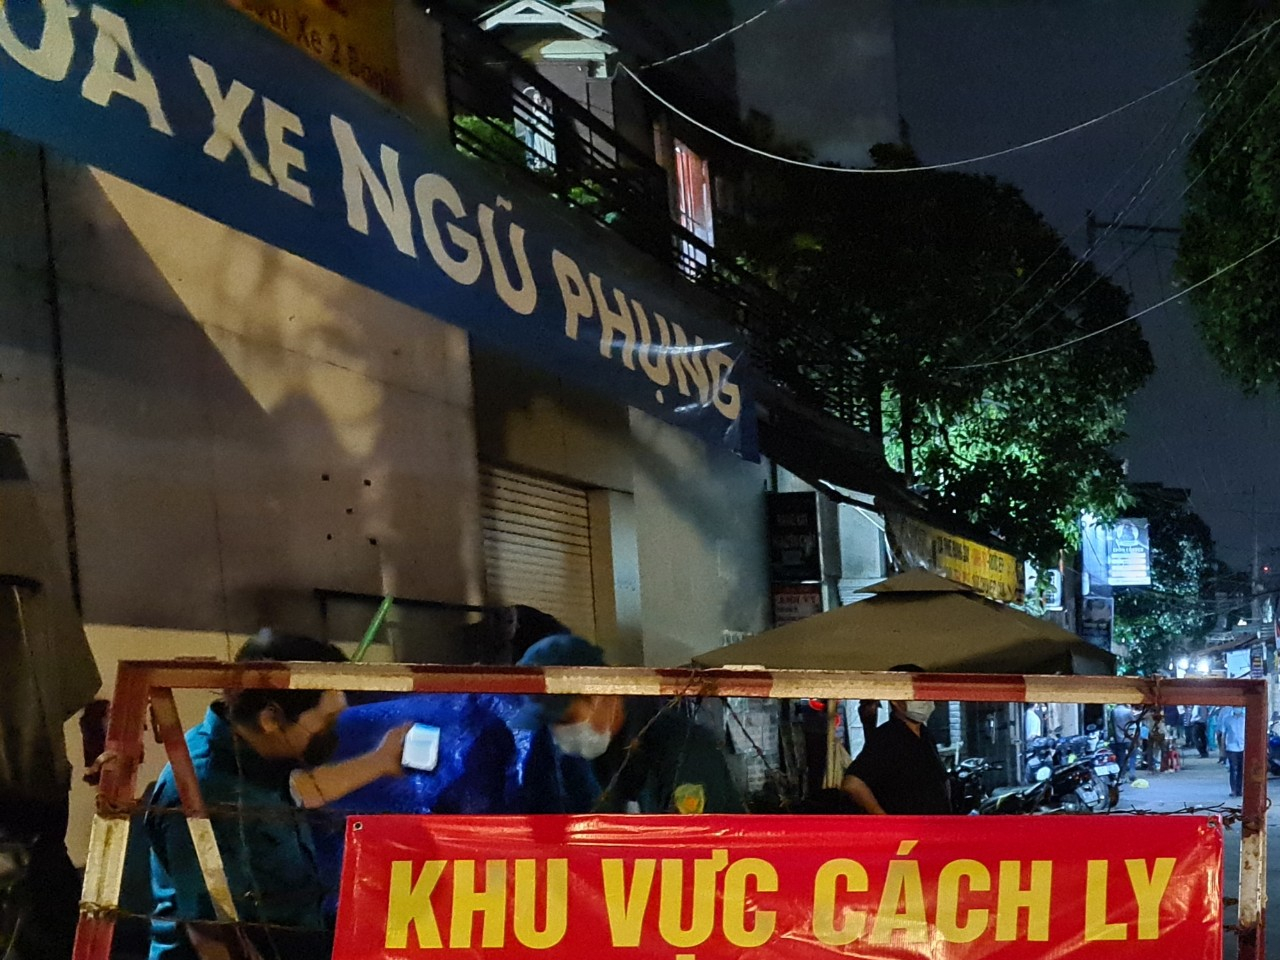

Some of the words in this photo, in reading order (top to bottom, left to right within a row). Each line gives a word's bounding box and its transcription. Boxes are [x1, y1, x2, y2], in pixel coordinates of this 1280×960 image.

[190, 56, 314, 206] XE
[331, 115, 538, 316] NGŨ
[550, 248, 742, 421] PHỤNG
[384, 858, 568, 949] KHU
[813, 840, 1052, 946] CÁCH
[1084, 857, 1176, 942] LY
